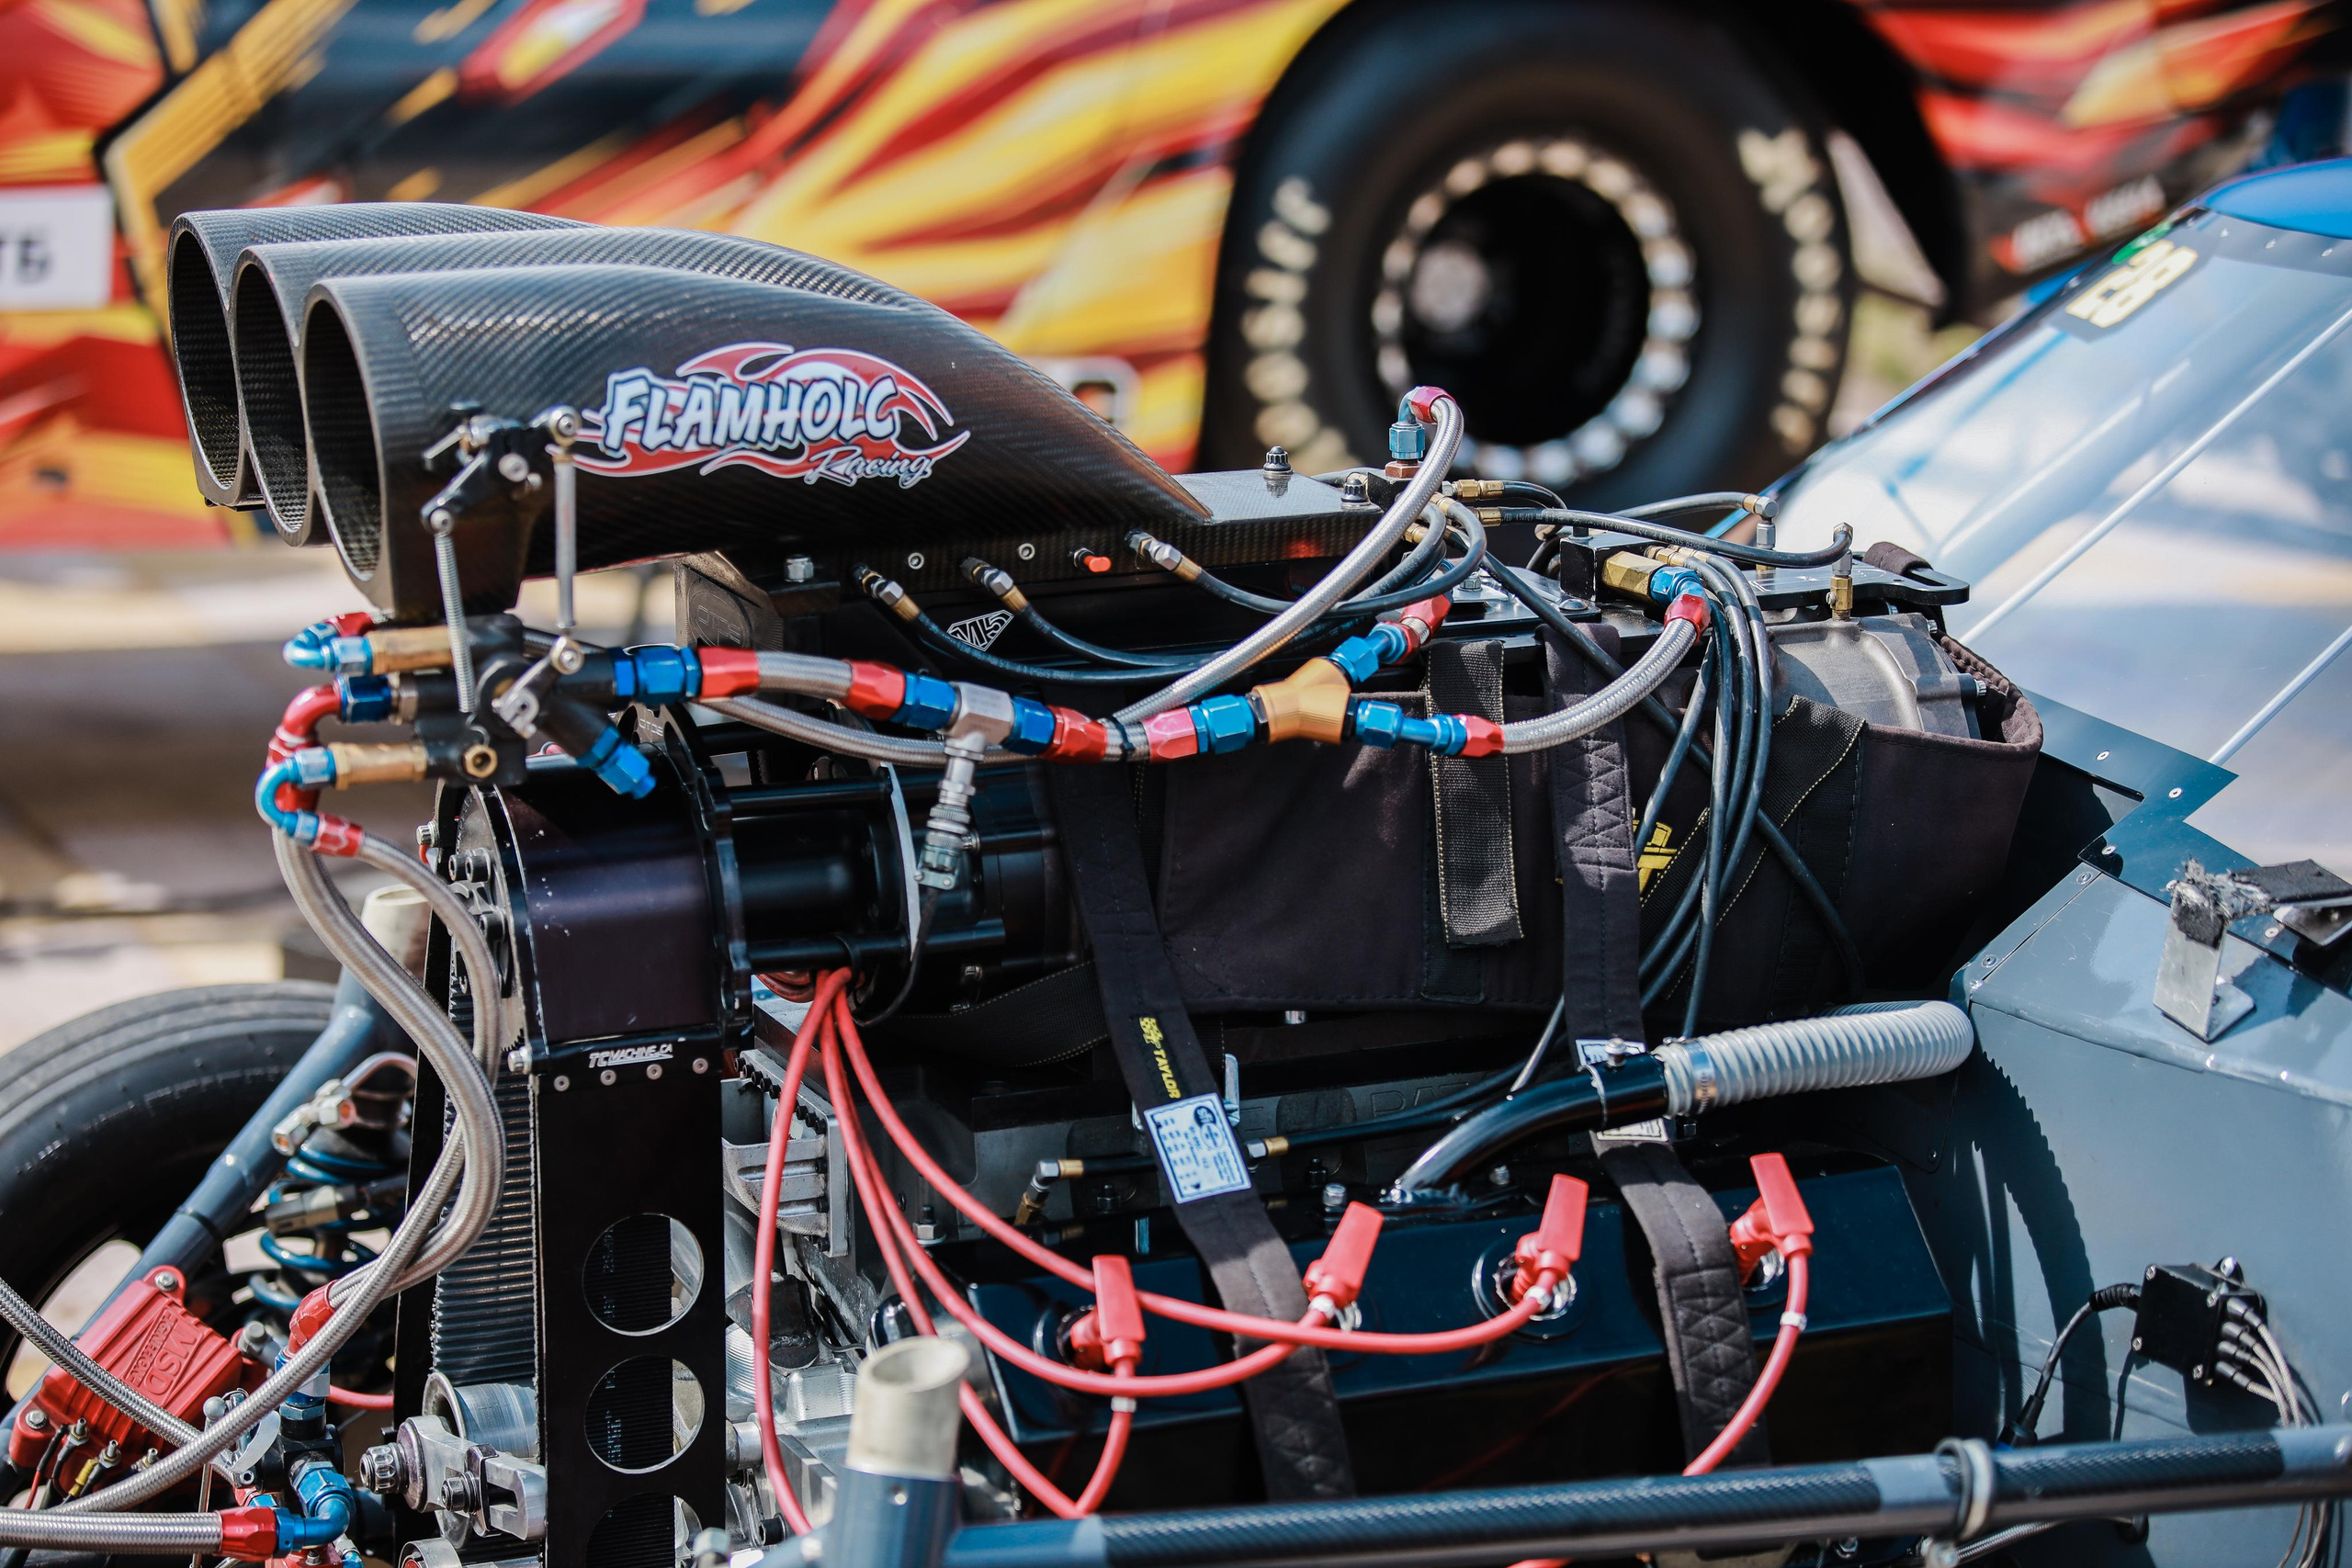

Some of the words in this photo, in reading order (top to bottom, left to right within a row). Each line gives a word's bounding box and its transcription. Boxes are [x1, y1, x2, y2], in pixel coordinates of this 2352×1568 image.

[603, 371, 899, 453] FLAMHOLC
[803, 445, 933, 489] Racing
[1153, 1049, 1182, 1099] TAYLOR
[130, 1316, 174, 1381] IGNITION
[143, 1324, 198, 1396] MSD
